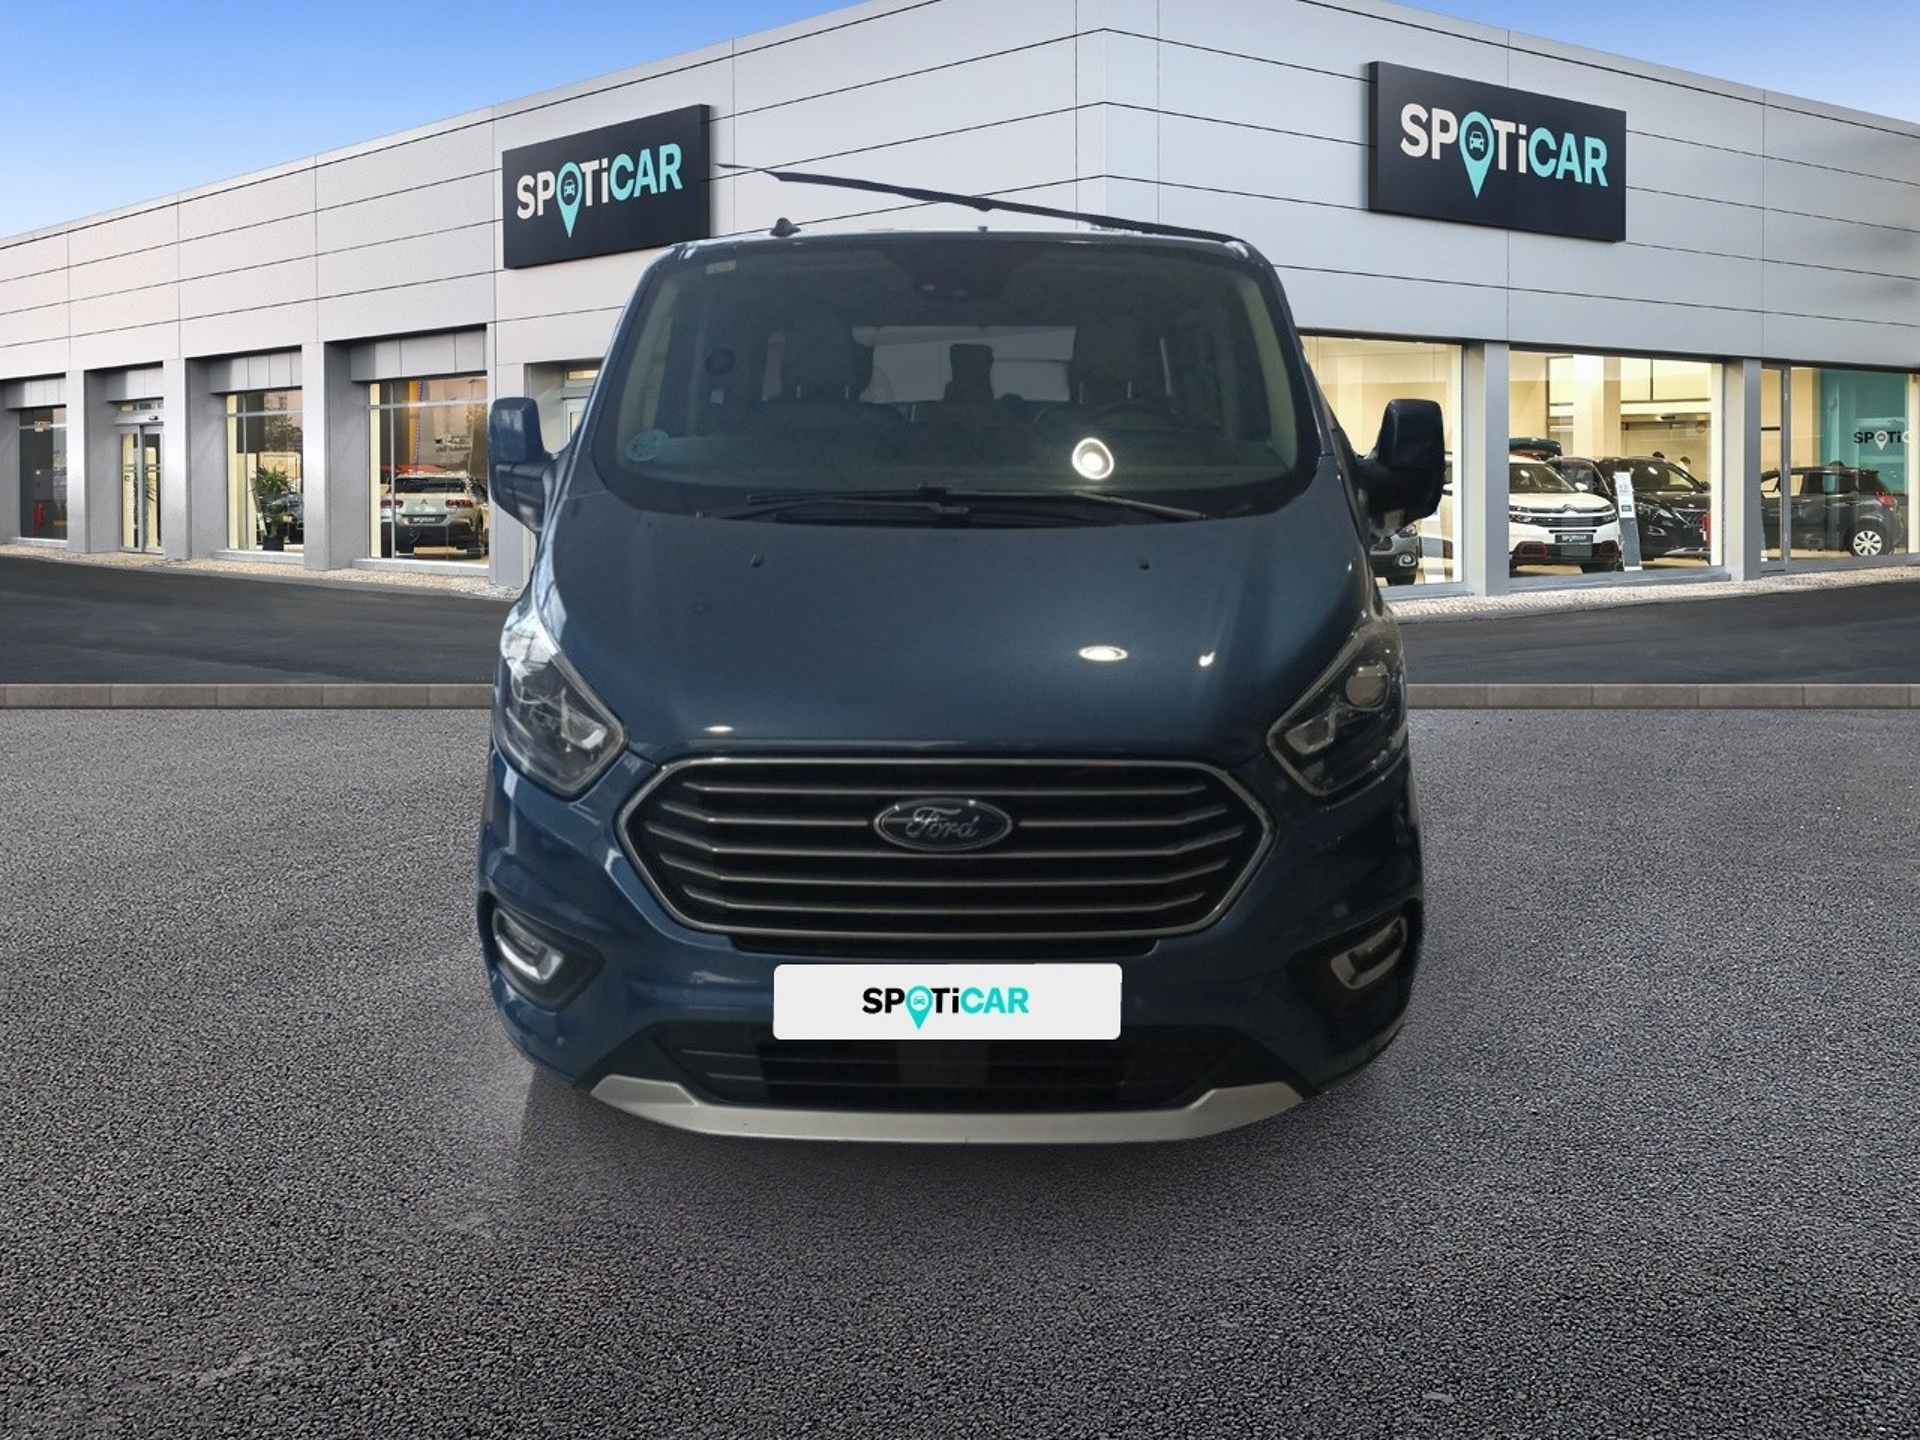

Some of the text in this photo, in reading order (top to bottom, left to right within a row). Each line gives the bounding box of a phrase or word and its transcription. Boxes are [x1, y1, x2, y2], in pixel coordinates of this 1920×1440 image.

[1400, 102, 1609, 198] SPOTiCAR
[516, 143, 683, 238] SPOTiCAR
[905, 806, 980, 838] Ford
[862, 985, 1030, 1030] SPOTiCAR
